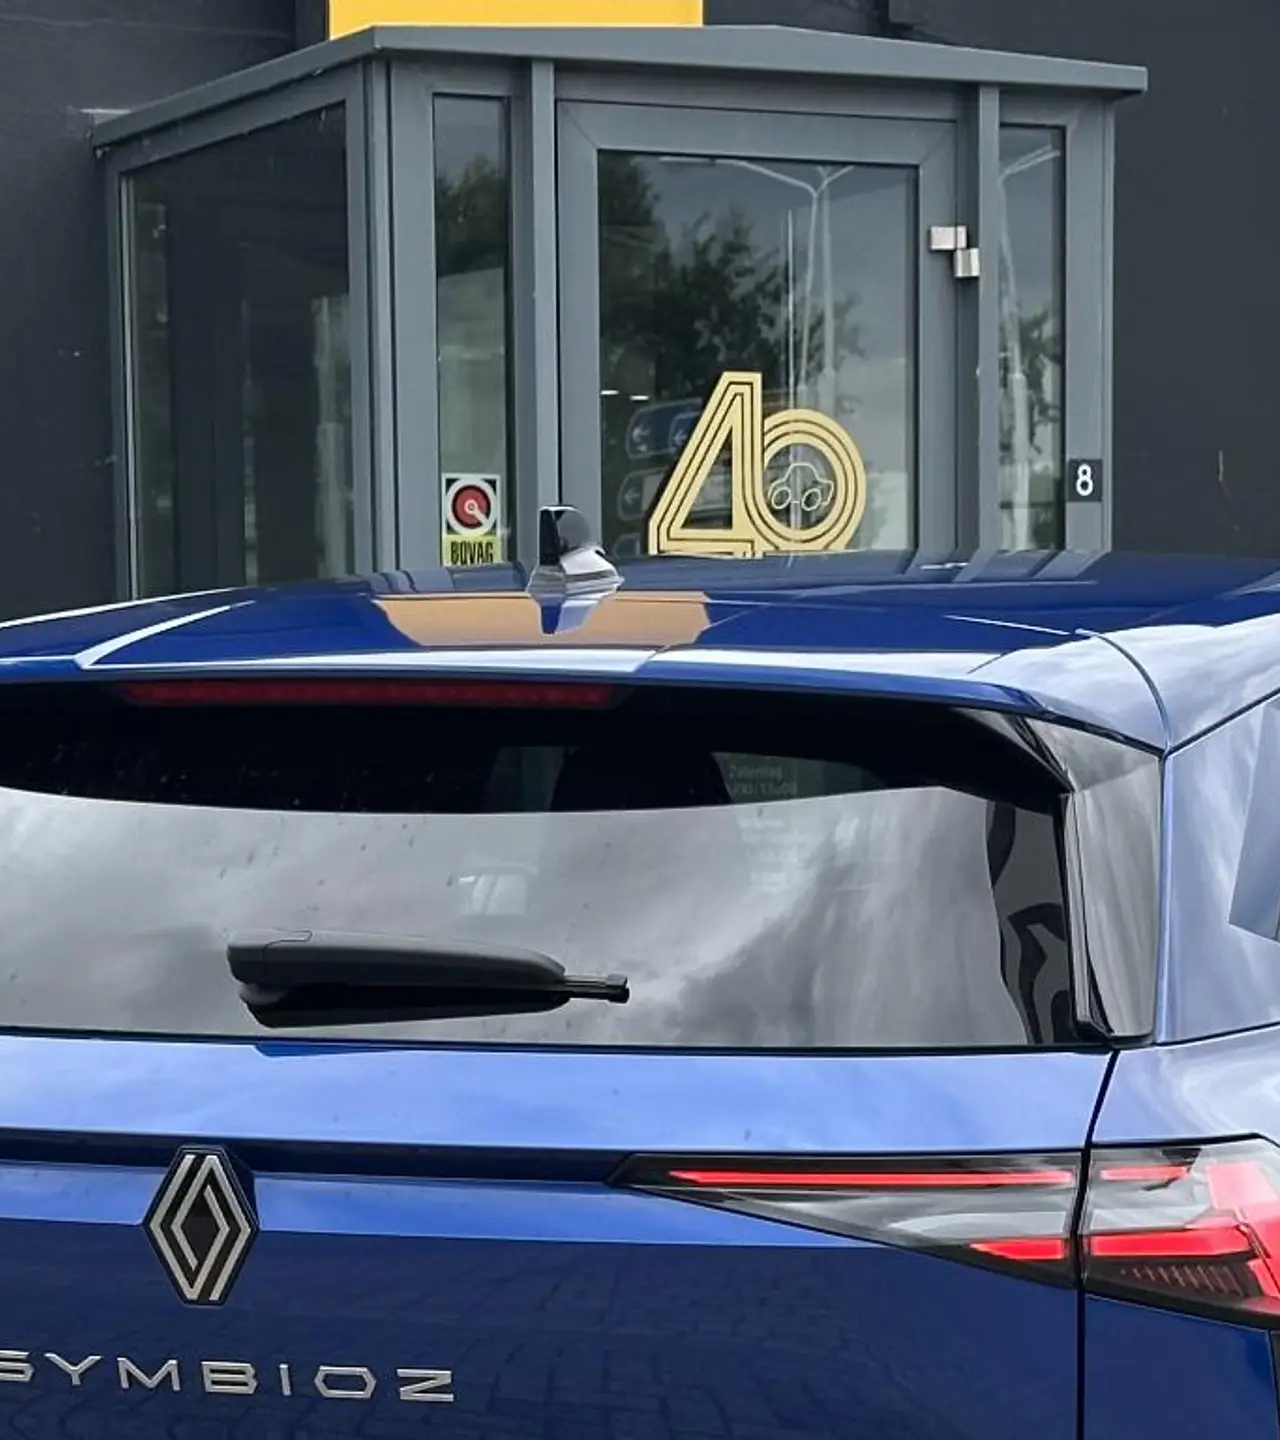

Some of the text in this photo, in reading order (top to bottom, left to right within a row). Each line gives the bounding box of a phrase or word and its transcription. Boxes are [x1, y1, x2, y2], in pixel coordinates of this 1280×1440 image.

[648, 371, 866, 558] 40
[1076, 463, 1093, 496] 8
[450, 541, 493, 565] BOVAG
